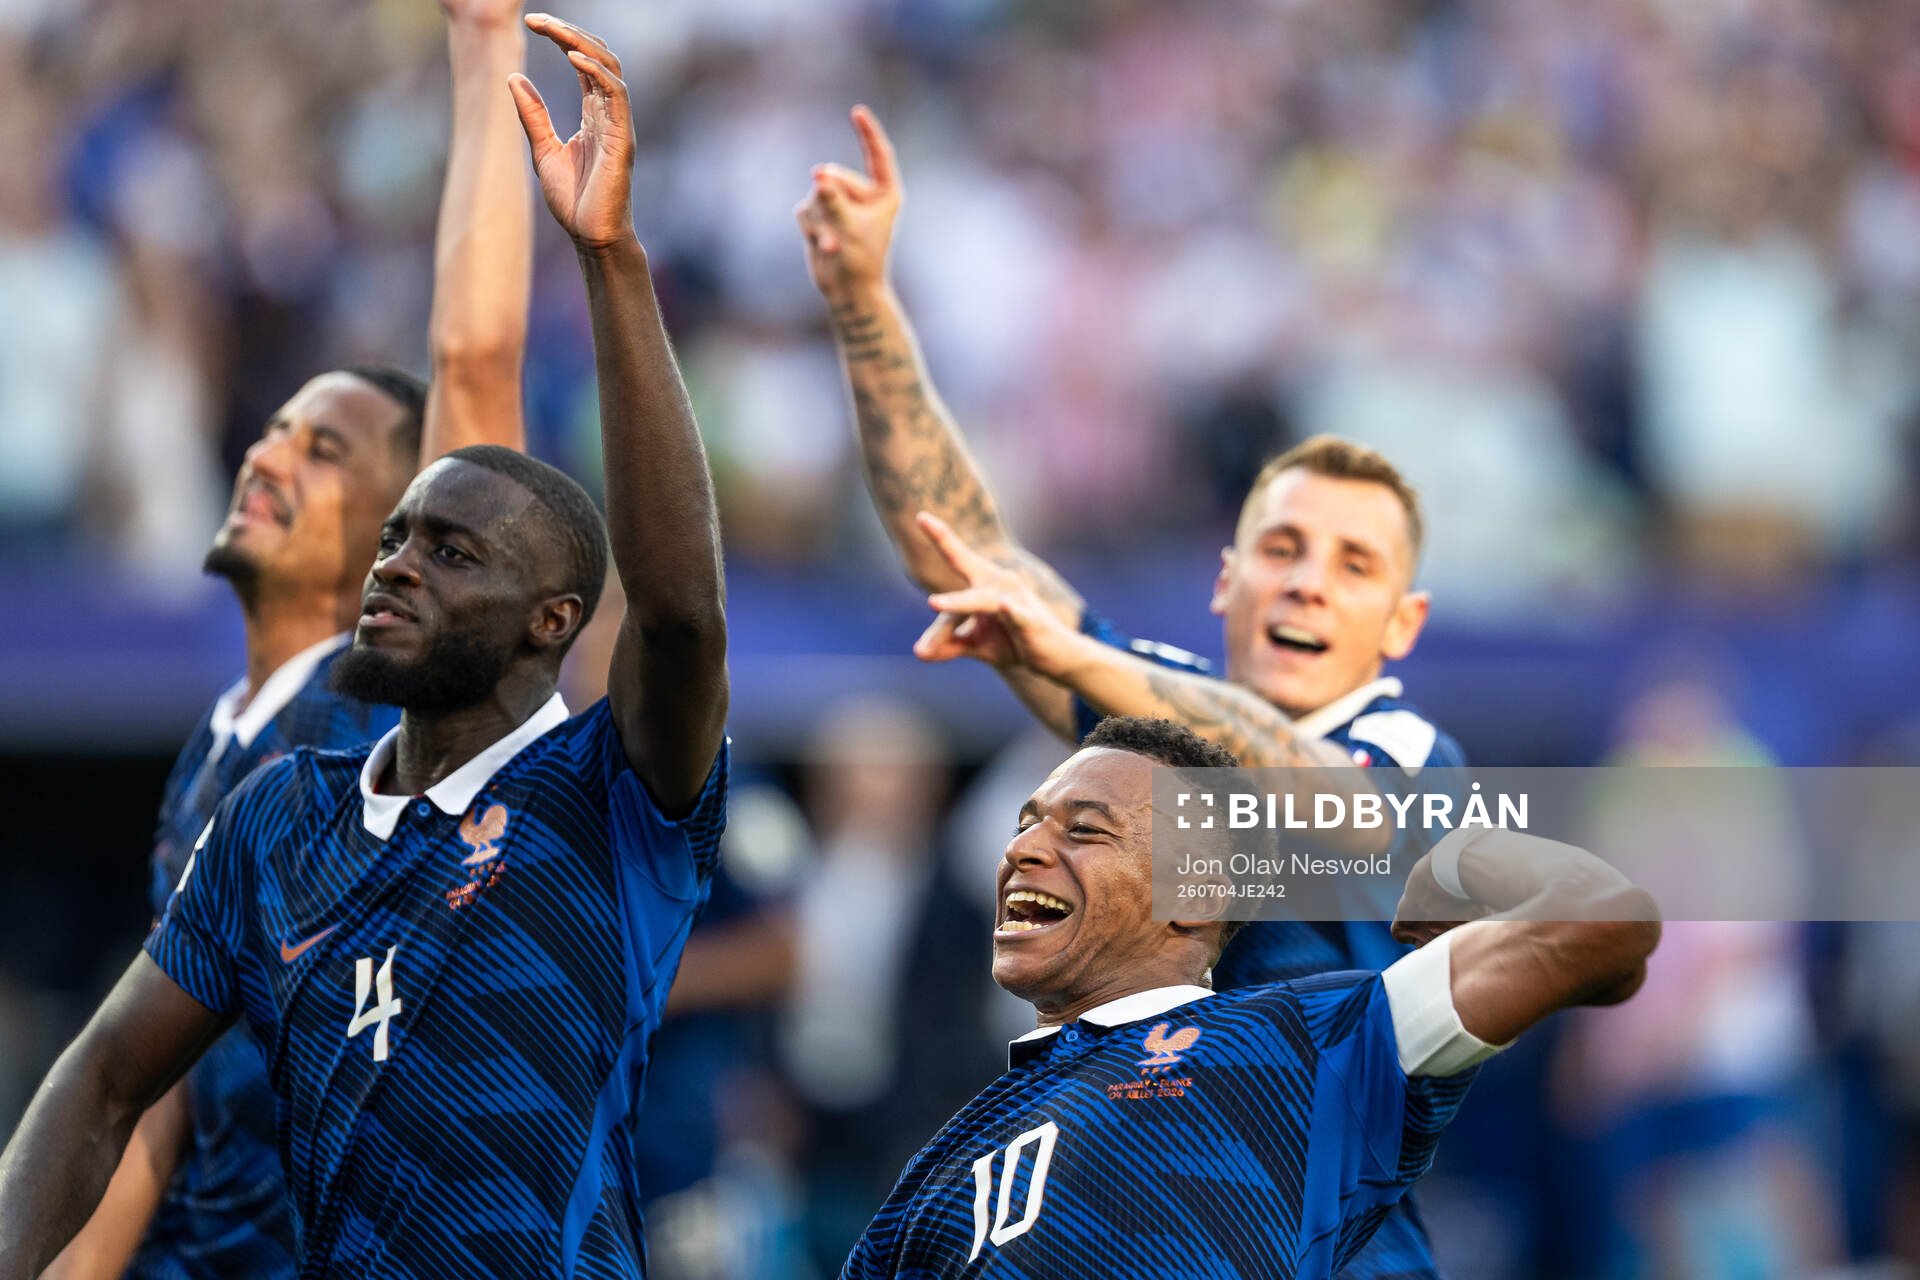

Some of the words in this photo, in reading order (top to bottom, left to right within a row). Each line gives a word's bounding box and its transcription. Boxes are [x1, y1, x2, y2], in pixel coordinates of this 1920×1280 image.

[347, 944, 401, 1062] 4
[1157, 1088, 1185, 1097] 2026
[1160, 1078, 1193, 1089] FRANCE
[968, 1121, 1059, 1264] 10
